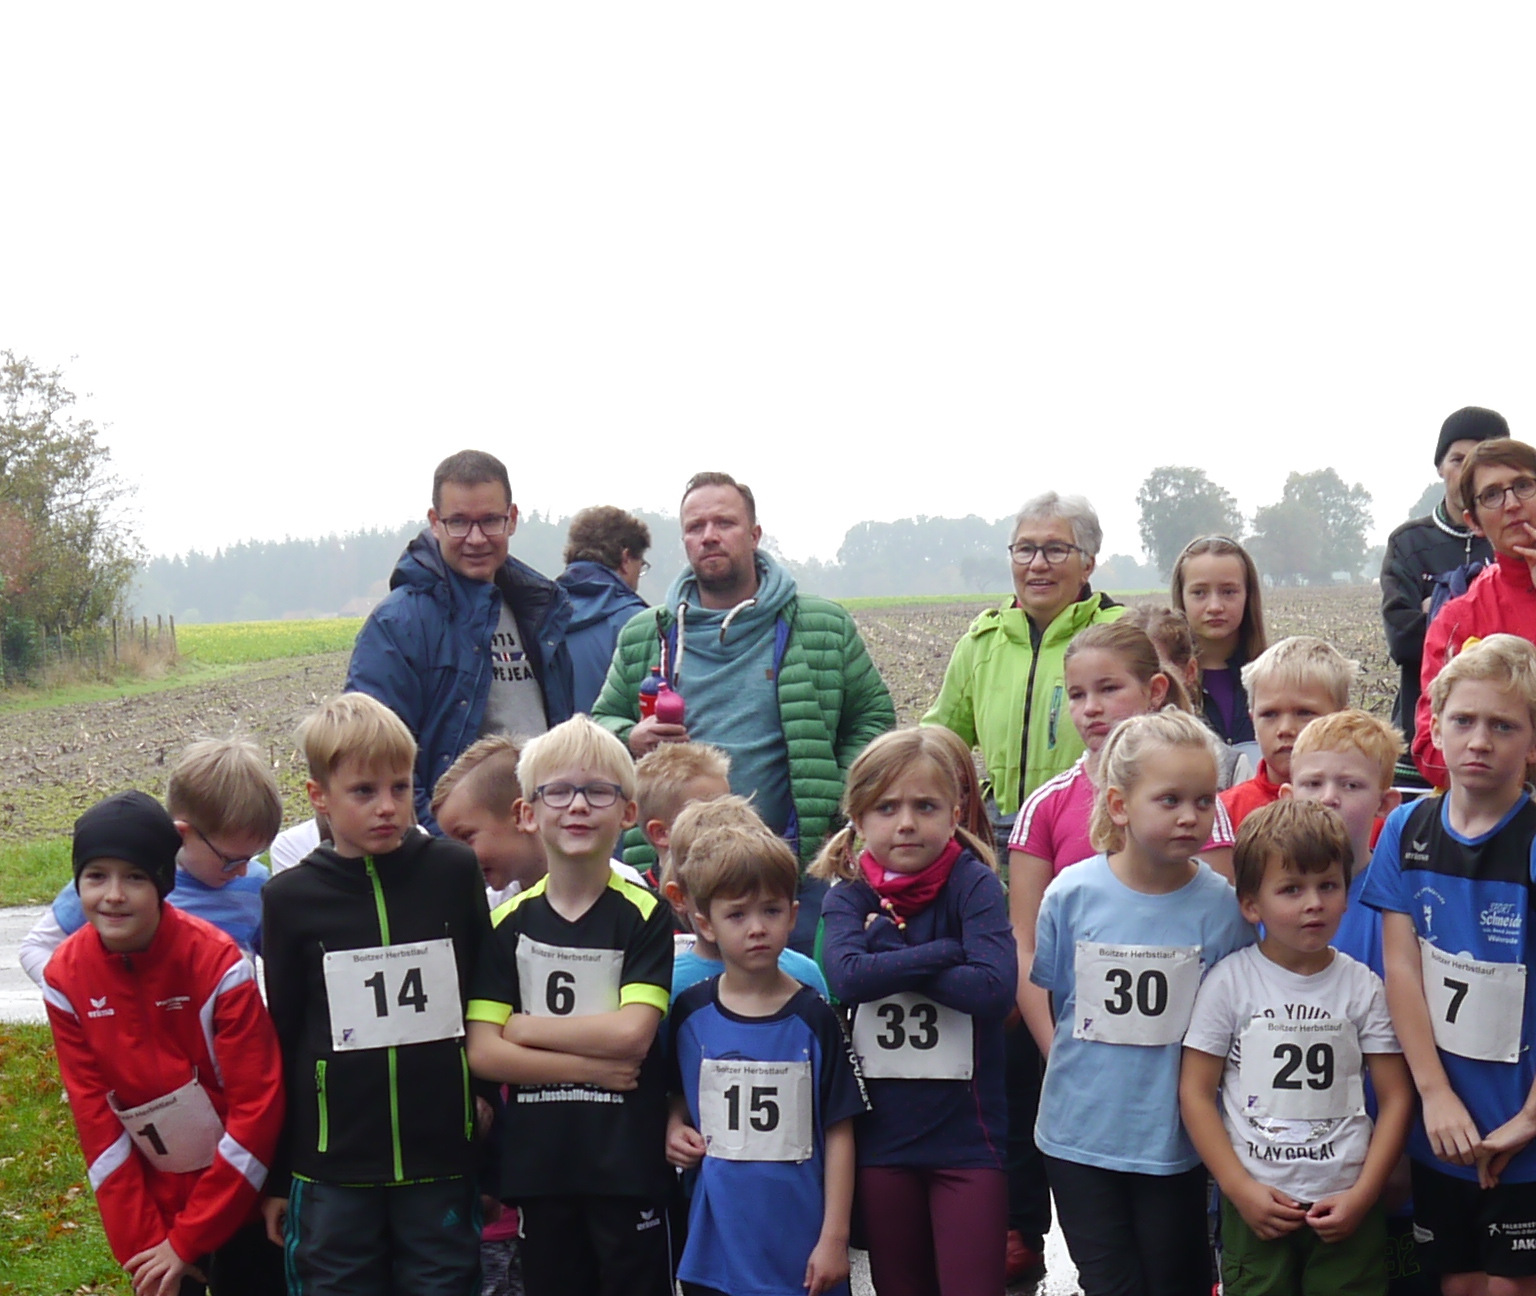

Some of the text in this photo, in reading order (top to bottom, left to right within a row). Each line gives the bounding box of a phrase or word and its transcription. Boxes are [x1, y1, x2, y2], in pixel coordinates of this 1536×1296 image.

[508, 666, 533, 681] JEA
[353, 946, 429, 963] Boitzer Herbstlauf
[557, 951, 602, 963] Herbstlauf
[1099, 948, 1176, 959] Boitzer Herbstlauf
[1452, 960, 1496, 976] Herbstlauf
[364, 967, 428, 1018] 14
[546, 970, 577, 1015] 6
[1104, 968, 1168, 1017] 30
[1443, 976, 1469, 1025] 7
[876, 1003, 939, 1050] 33
[1267, 1023, 1343, 1033] Boitzer Herbstlauf
[744, 1066, 789, 1076] Herbstlauf
[1272, 1042, 1335, 1090] 29
[723, 1084, 780, 1132] 15
[137, 1122, 168, 1156] 1
